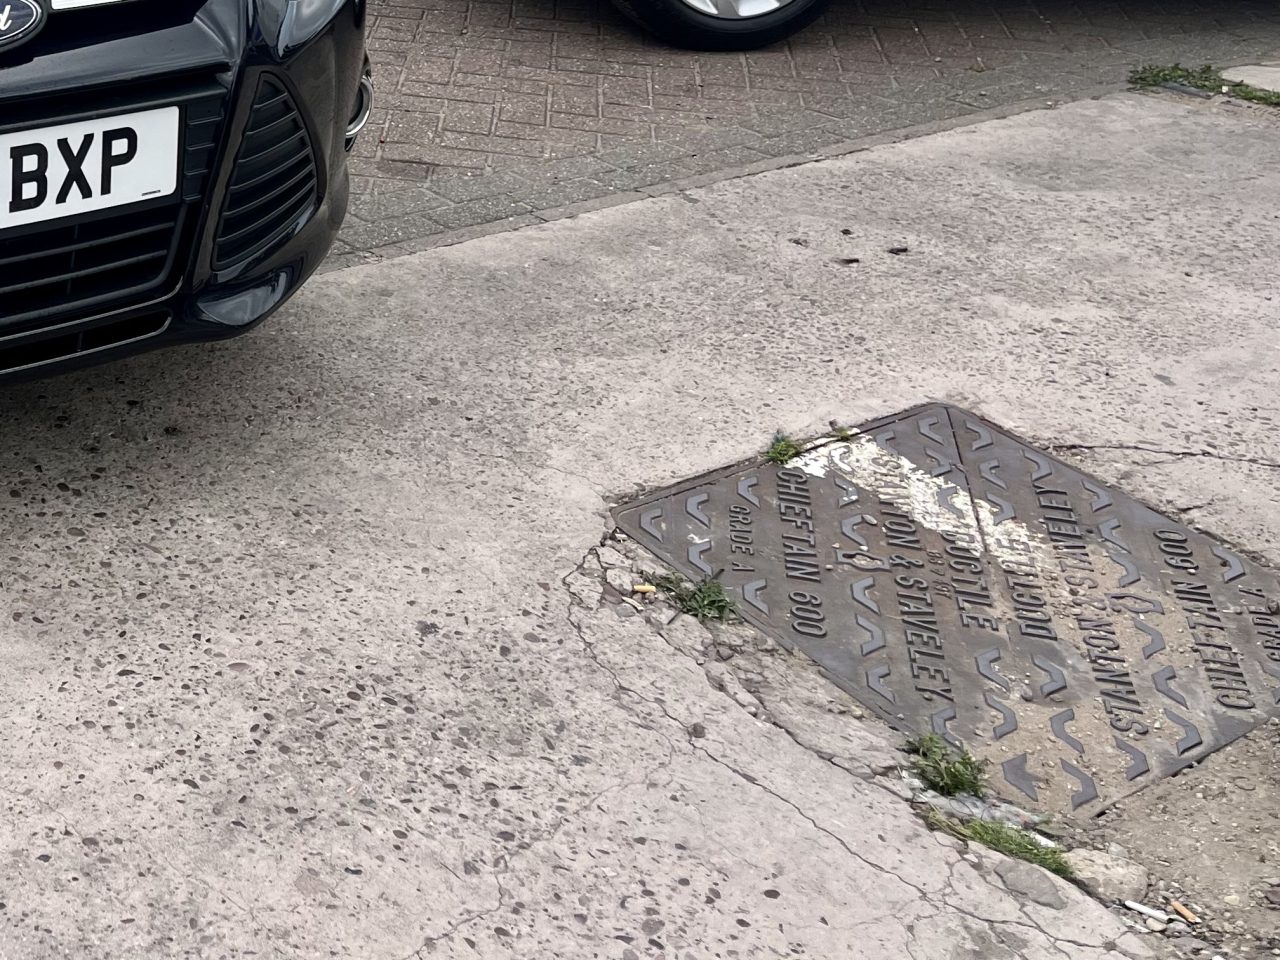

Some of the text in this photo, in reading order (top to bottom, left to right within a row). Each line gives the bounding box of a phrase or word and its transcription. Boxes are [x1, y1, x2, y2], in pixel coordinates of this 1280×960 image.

[9, 126, 138, 213] BXP
[729, 504, 756, 572] GRADE A
[776, 470, 828, 639] CHIEFTAIN 600
[888, 553, 925, 570] &
[941, 528, 1000, 632] DUCTILE
[894, 574, 956, 702] STAVELEY
[1152, 529, 1256, 709] CHIEFTAIN 600
[1076, 616, 1150, 735] STANTON
